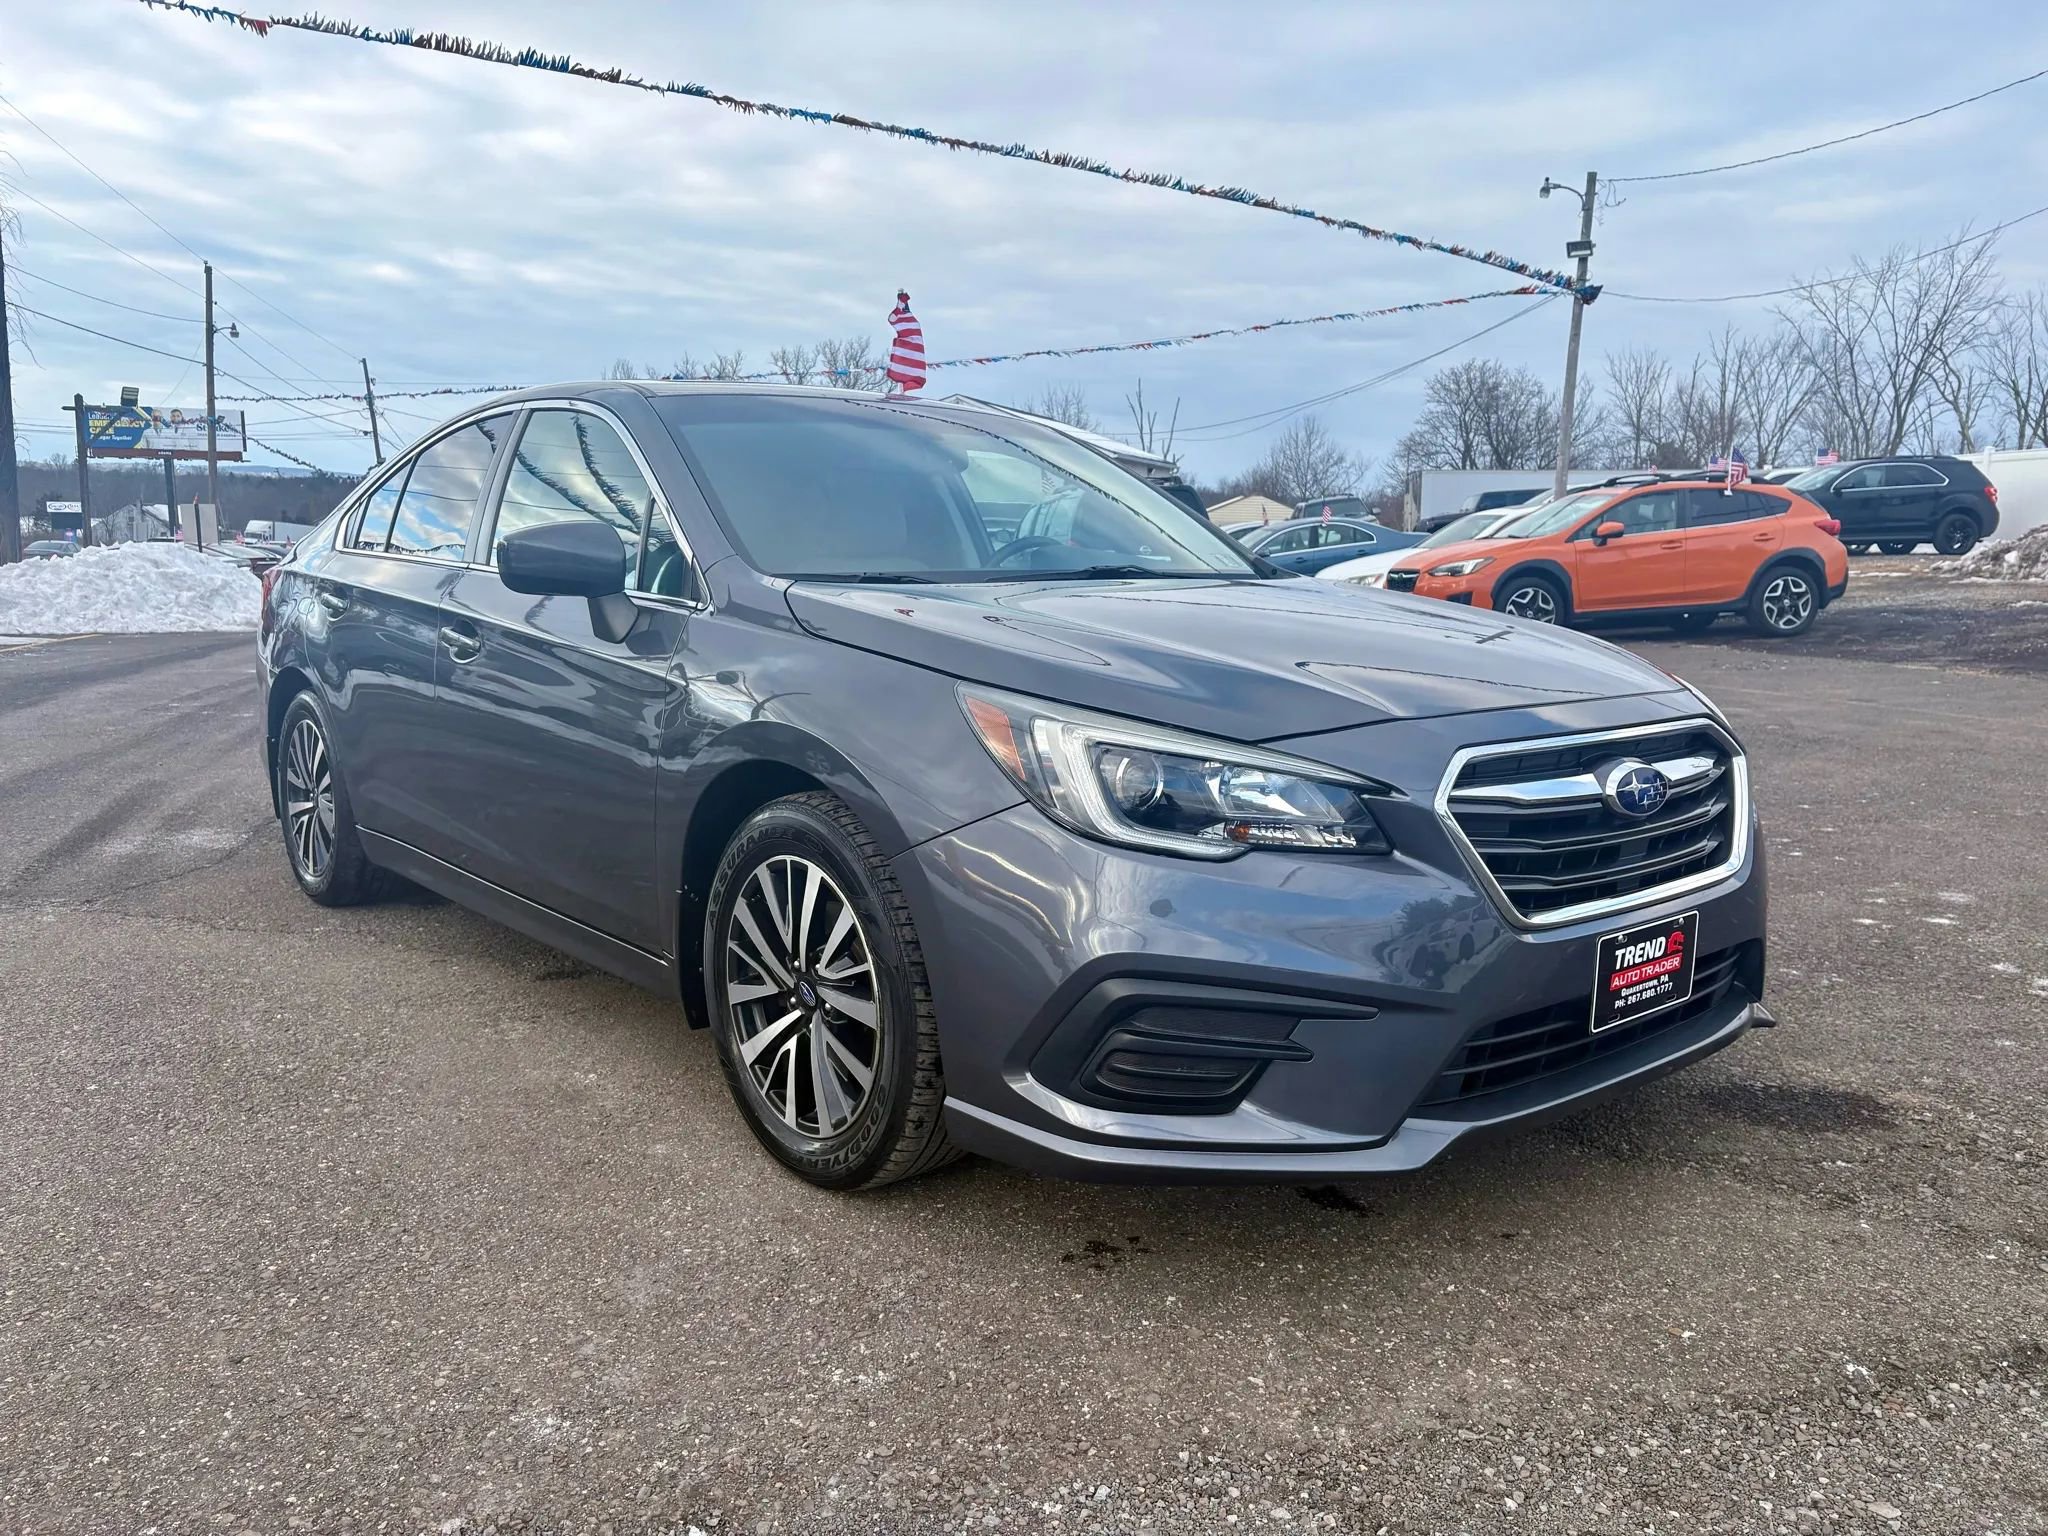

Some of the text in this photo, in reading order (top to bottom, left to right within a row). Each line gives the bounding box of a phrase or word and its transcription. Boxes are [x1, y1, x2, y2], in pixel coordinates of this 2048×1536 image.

[1615, 936, 1666, 970] TREND
[1612, 957, 1680, 988] AUTO TRADER
[1660, 973, 1670, 984] PA
[1614, 981, 1673, 1010] PH: 267.680.1777
